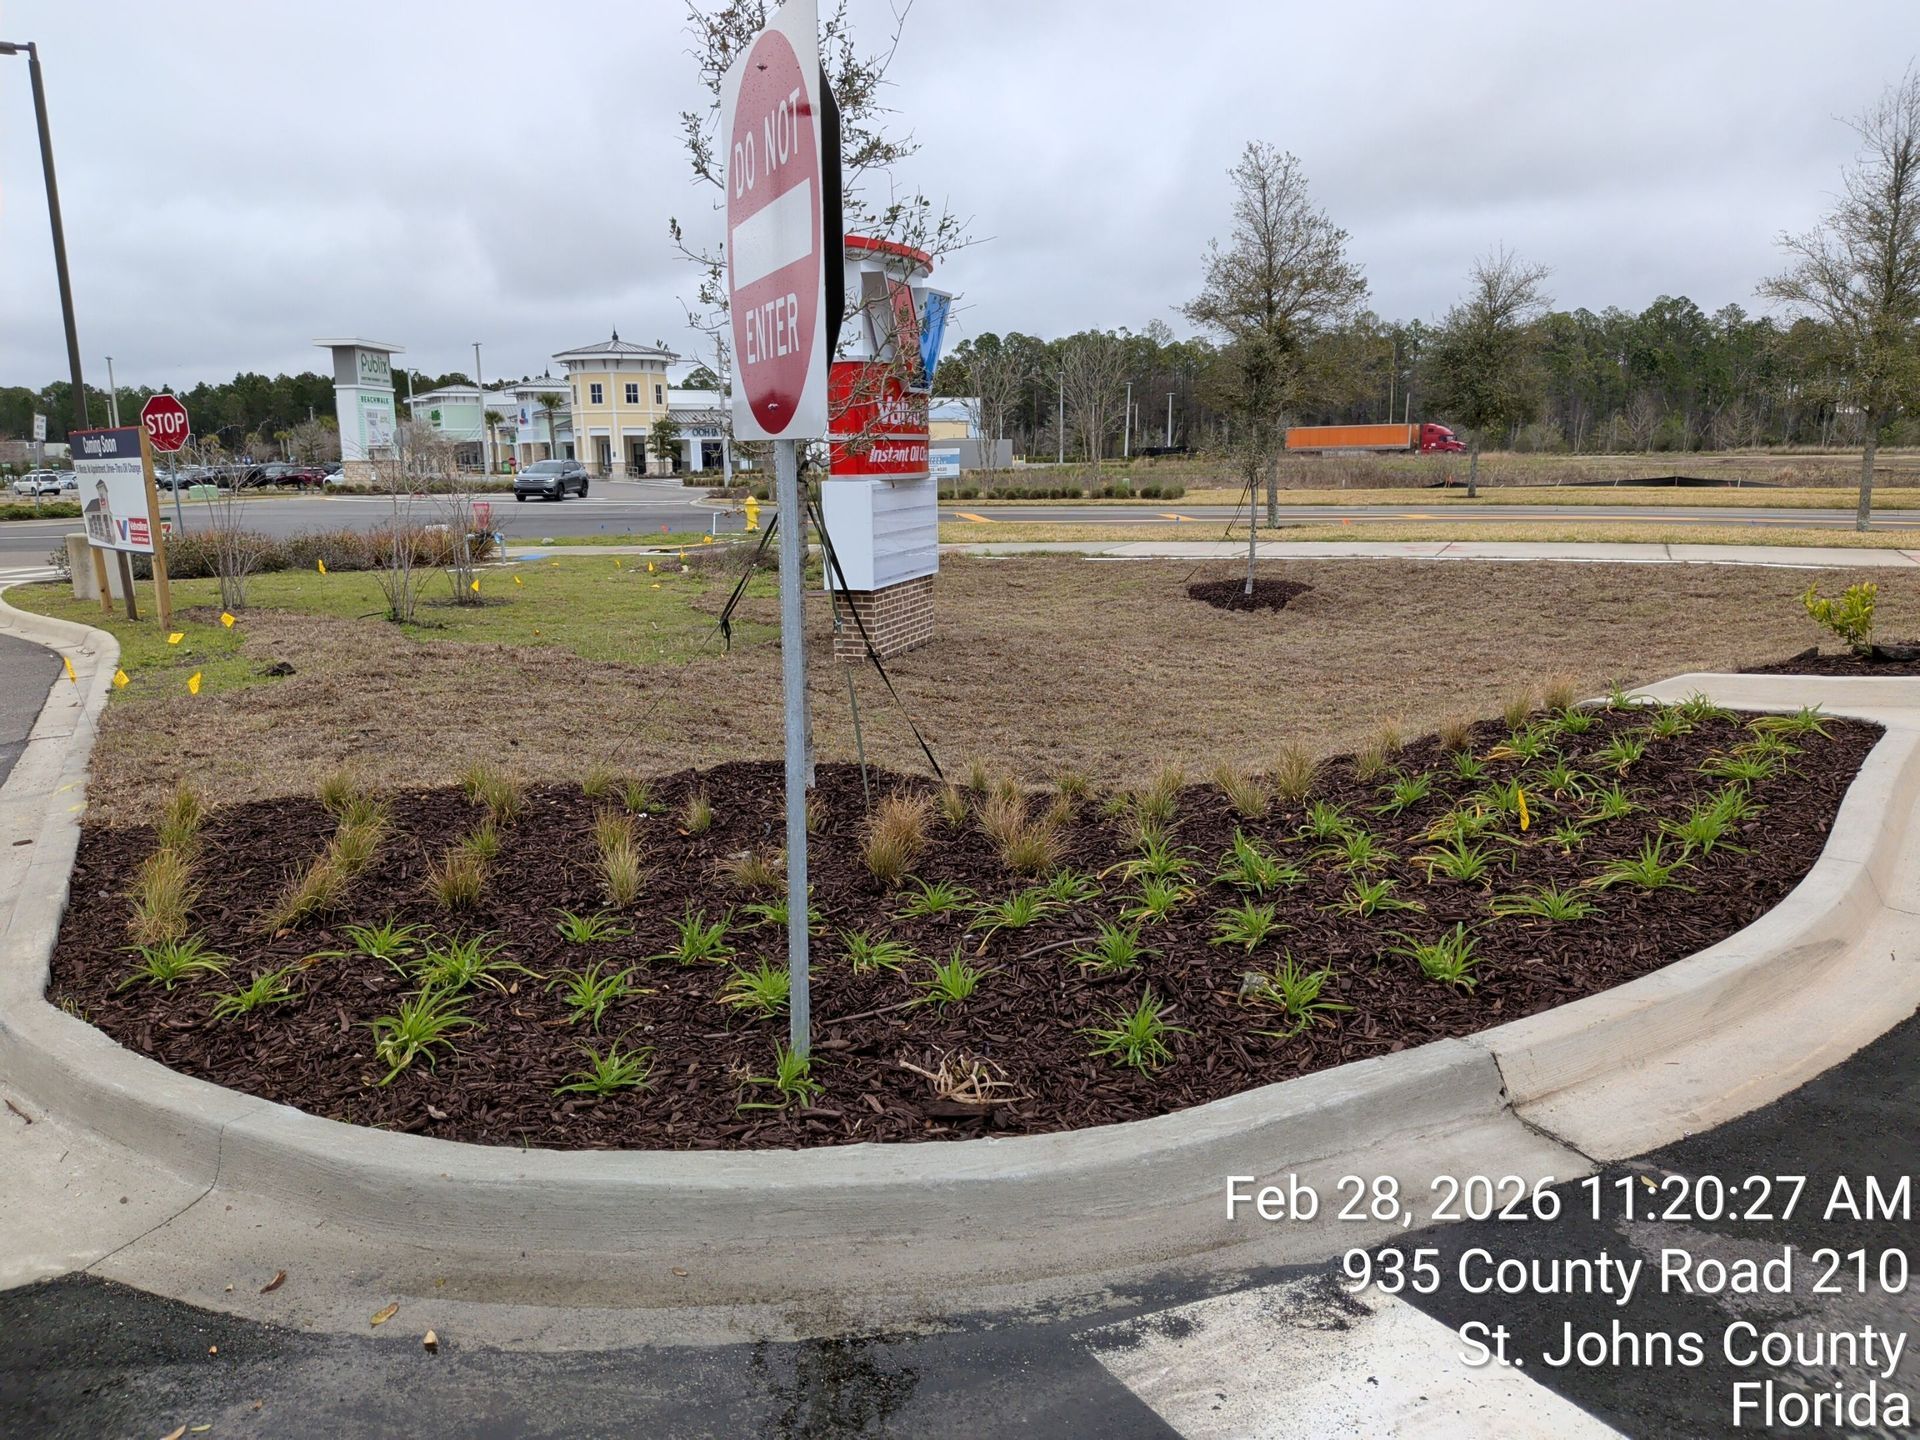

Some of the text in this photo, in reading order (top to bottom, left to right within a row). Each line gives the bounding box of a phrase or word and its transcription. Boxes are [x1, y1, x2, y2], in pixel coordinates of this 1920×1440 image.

[735, 87, 800, 199] DO NOT
[746, 292, 799, 364] ENTER
[361, 353, 388, 375] Publix
[146, 412, 184, 435] STOP
[82, 435, 117, 457] Coming Soon
[869, 446, 910, 463] Instant
[910, 446, 919, 462] Oil
